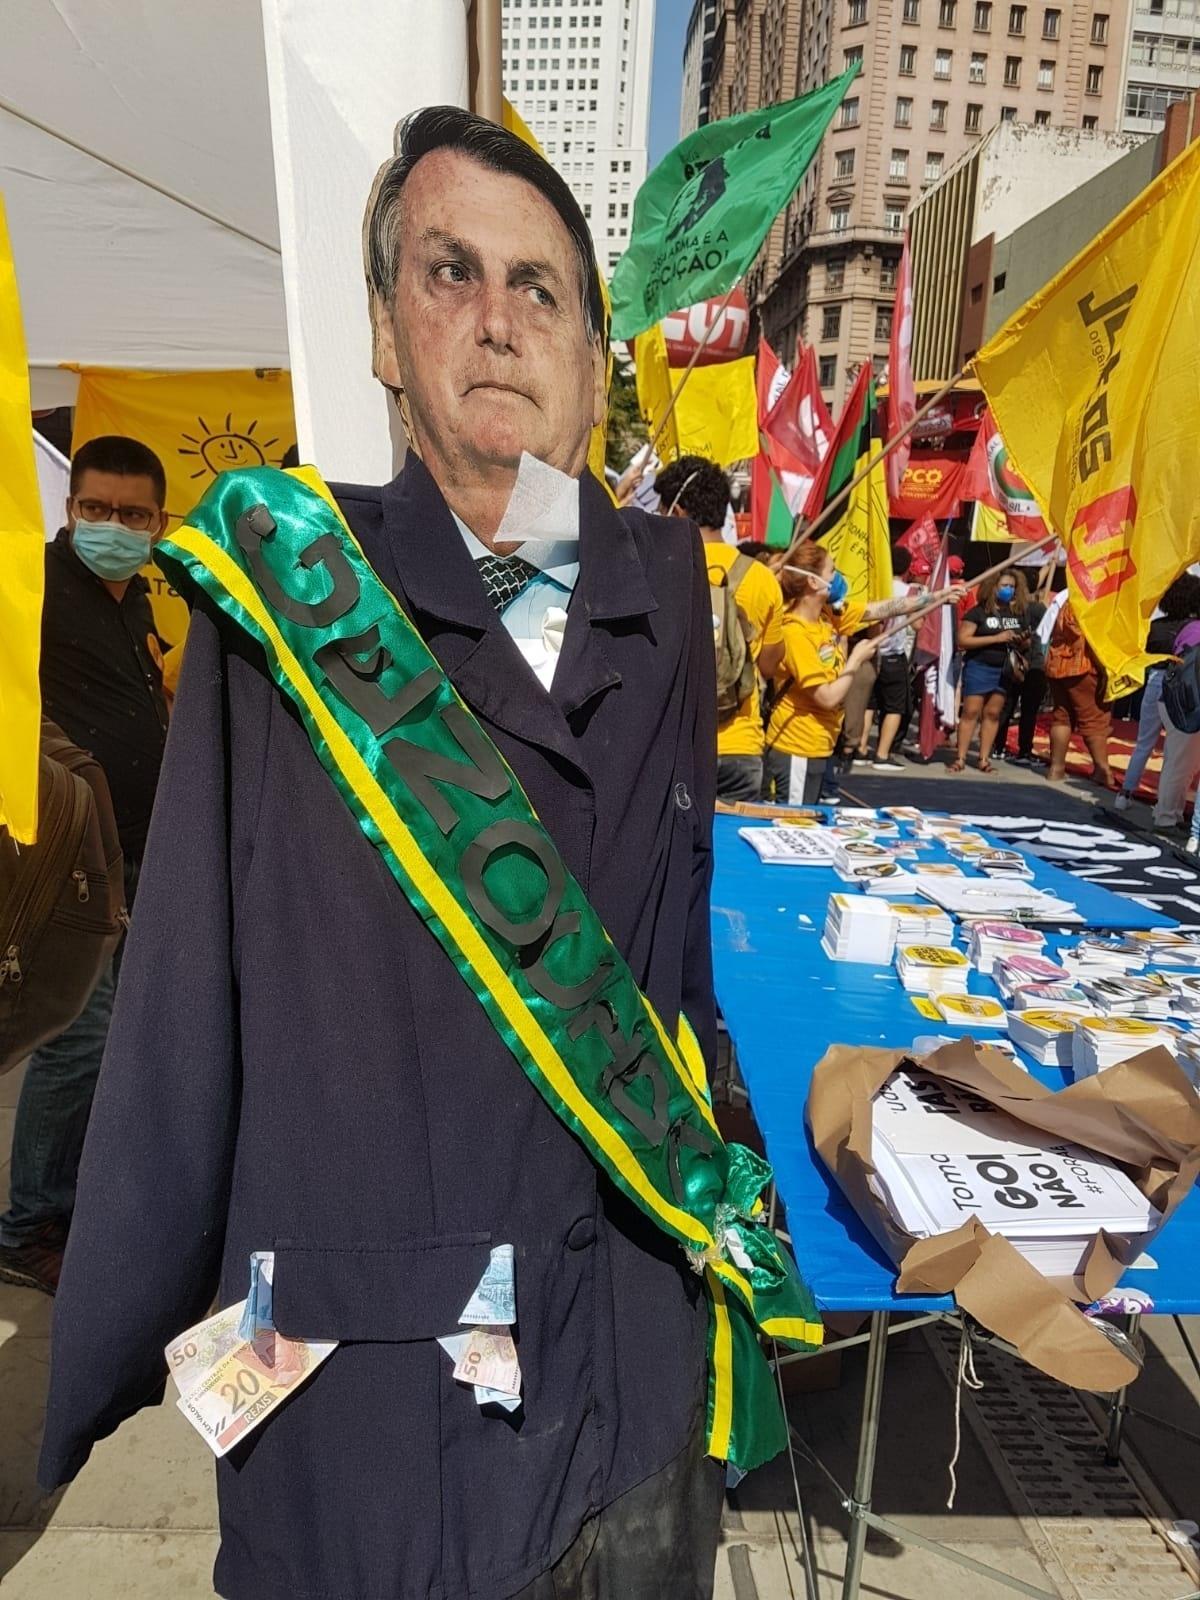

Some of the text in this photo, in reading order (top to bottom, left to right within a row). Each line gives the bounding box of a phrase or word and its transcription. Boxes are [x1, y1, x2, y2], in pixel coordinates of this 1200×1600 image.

[716, 229, 729, 243] A
[234, 502, 716, 1206] GENOCIDA
[1028, 1162, 1086, 1208] NÃO
[172, 1342, 198, 1368] 50
[464, 1351, 482, 1378] 50
[220, 1369, 260, 1414] 20
[243, 1394, 272, 1424] REAIS
